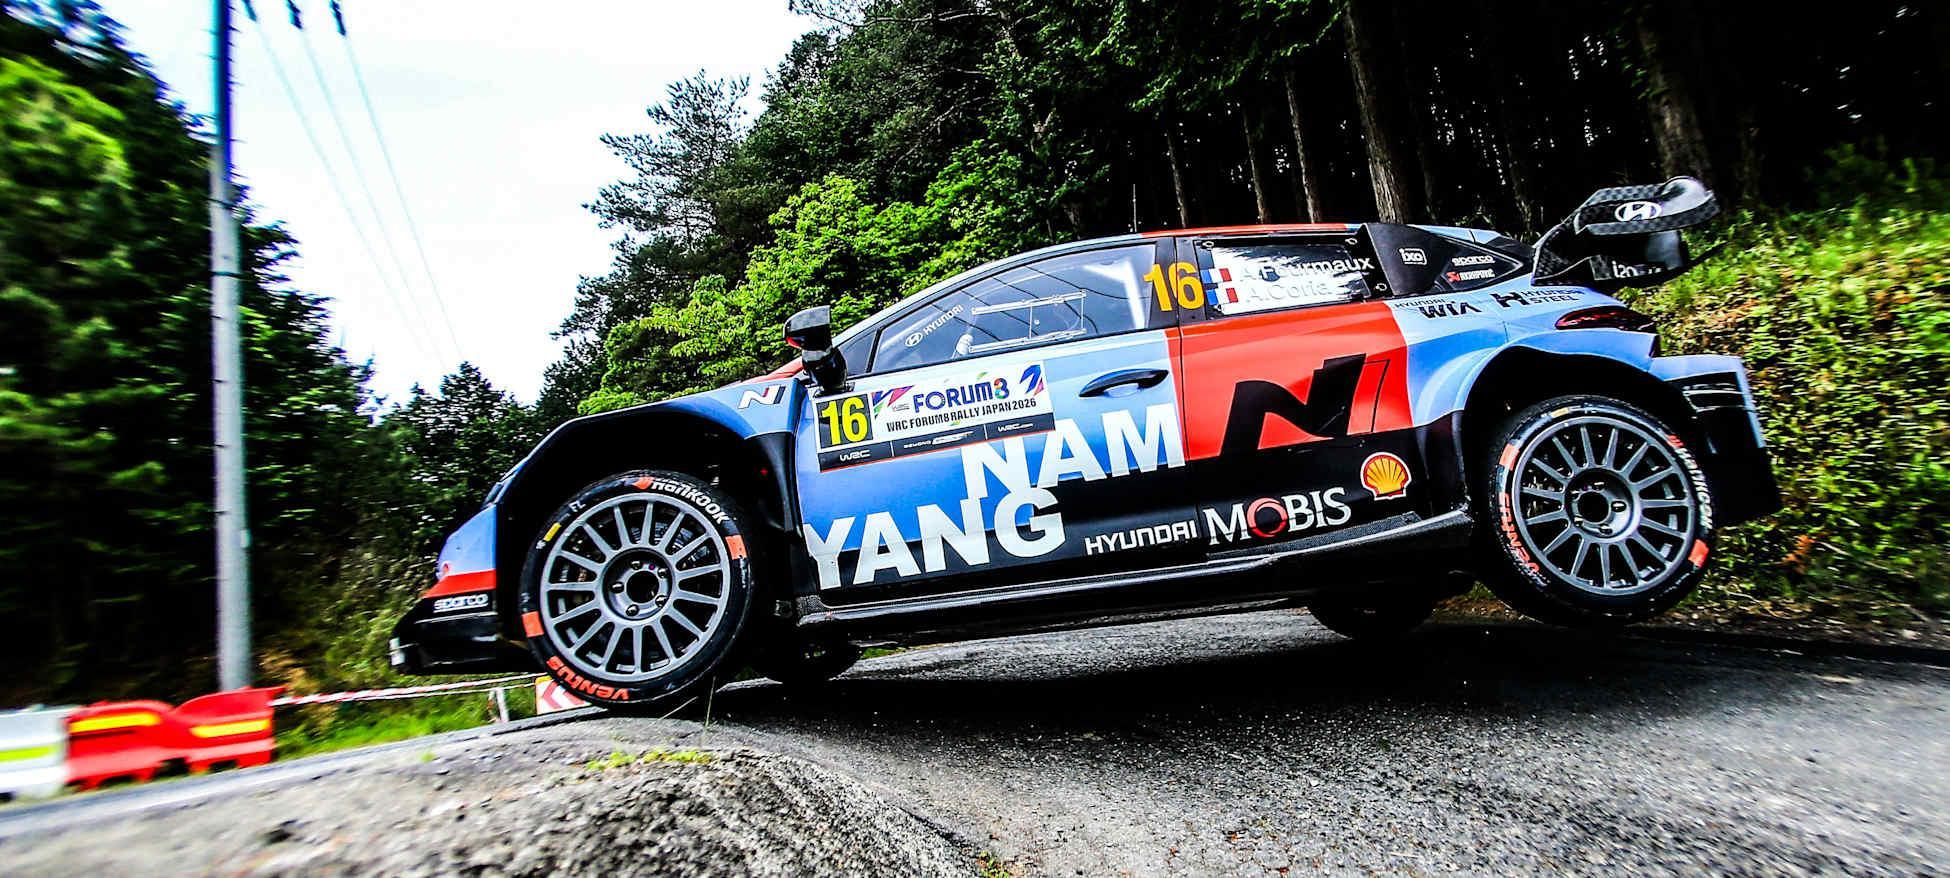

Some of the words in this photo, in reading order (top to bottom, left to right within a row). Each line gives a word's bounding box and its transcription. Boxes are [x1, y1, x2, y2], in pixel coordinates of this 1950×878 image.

[1452, 255, 1495, 266] sparco
[1144, 262, 1204, 312] 16
[1394, 298, 1446, 308] HYUNDAI
[1529, 295, 1579, 304] STEEL
[923, 304, 964, 336] HYUNDAI
[1418, 301, 1482, 319] WIA
[913, 377, 1010, 413] FORUM8
[822, 396, 868, 446] 16
[887, 418, 908, 432] WRC
[910, 412, 950, 429] FORUM8
[951, 406, 980, 422] RALLY
[982, 402, 1012, 416] JAPAN
[1013, 397, 1037, 411] 2026
[840, 449, 871, 461] WRC
[960, 403, 1186, 501] NAM
[1202, 486, 1352, 545] MOBIS
[803, 488, 1066, 590] YANG
[1085, 519, 1198, 555] HYUNDAI
[434, 593, 489, 613] sparco
[546, 655, 631, 701] VENTUS
